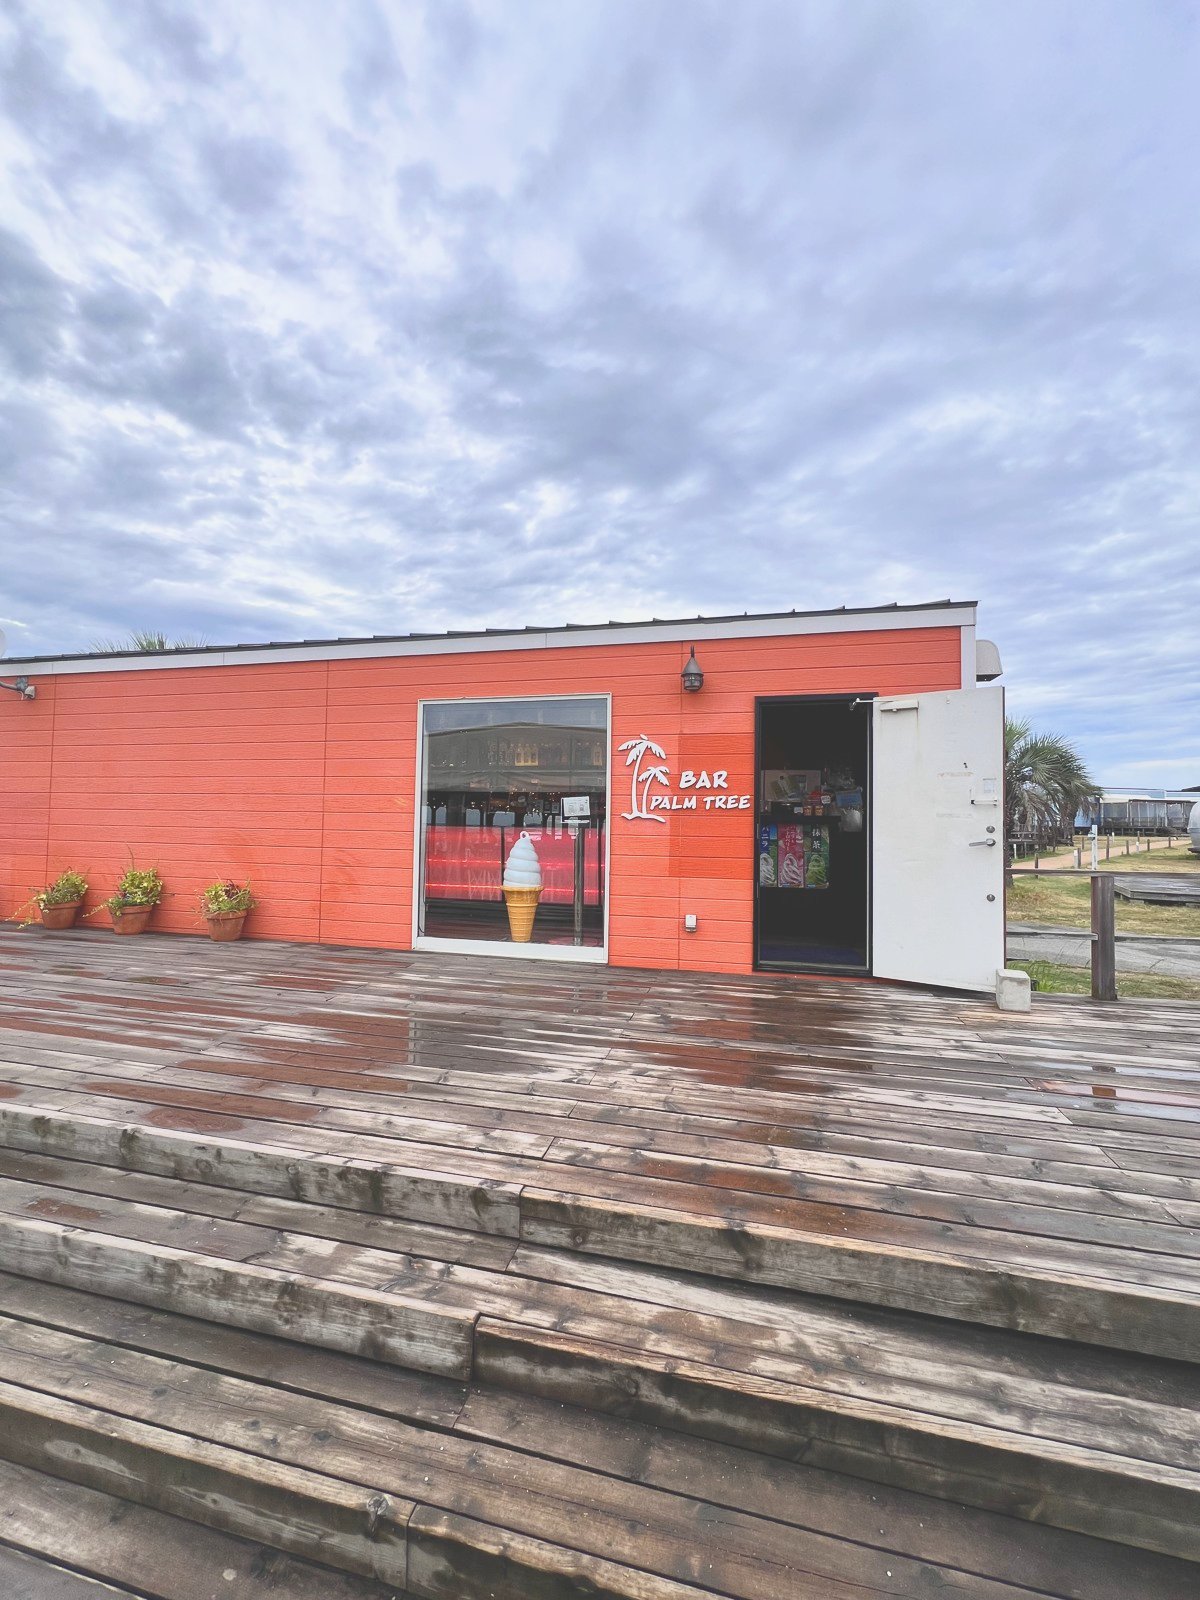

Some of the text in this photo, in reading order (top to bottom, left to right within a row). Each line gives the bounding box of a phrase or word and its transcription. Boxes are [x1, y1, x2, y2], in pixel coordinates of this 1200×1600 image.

[679, 770, 728, 788] BAR
[650, 795, 750, 810] PALM TREE
